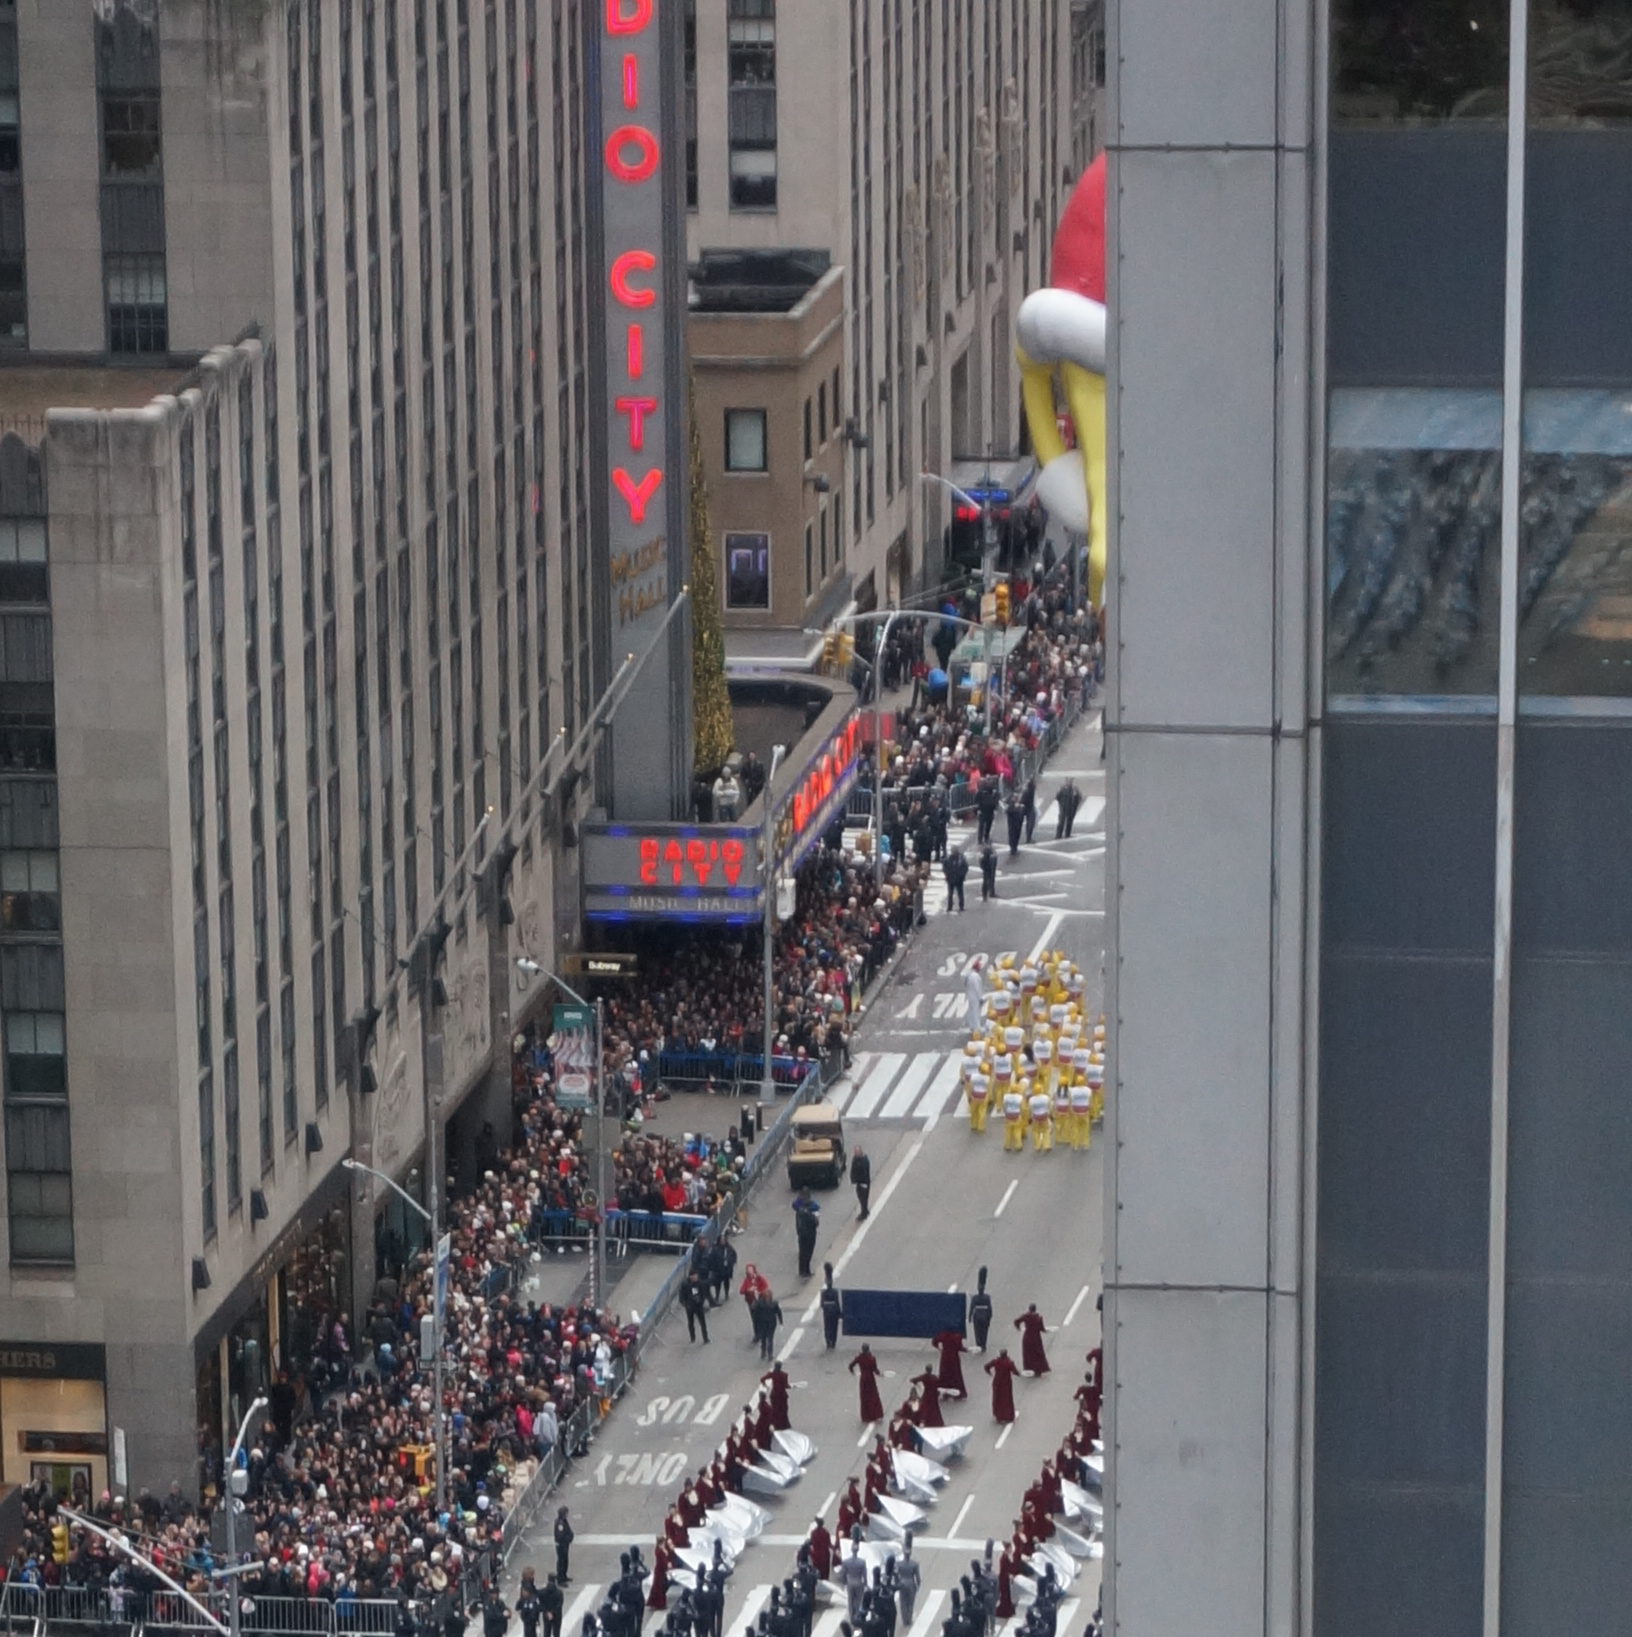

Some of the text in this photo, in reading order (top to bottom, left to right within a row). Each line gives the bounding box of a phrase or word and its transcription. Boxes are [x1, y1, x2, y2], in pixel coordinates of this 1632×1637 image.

[610, 249, 663, 522] CITY
[619, 577, 667, 627] HALL
[639, 839, 745, 862] RADIO
[639, 862, 743, 885] CITY
[637, 1394, 730, 1426] BUS
[594, 1453, 688, 1486] ONLY
